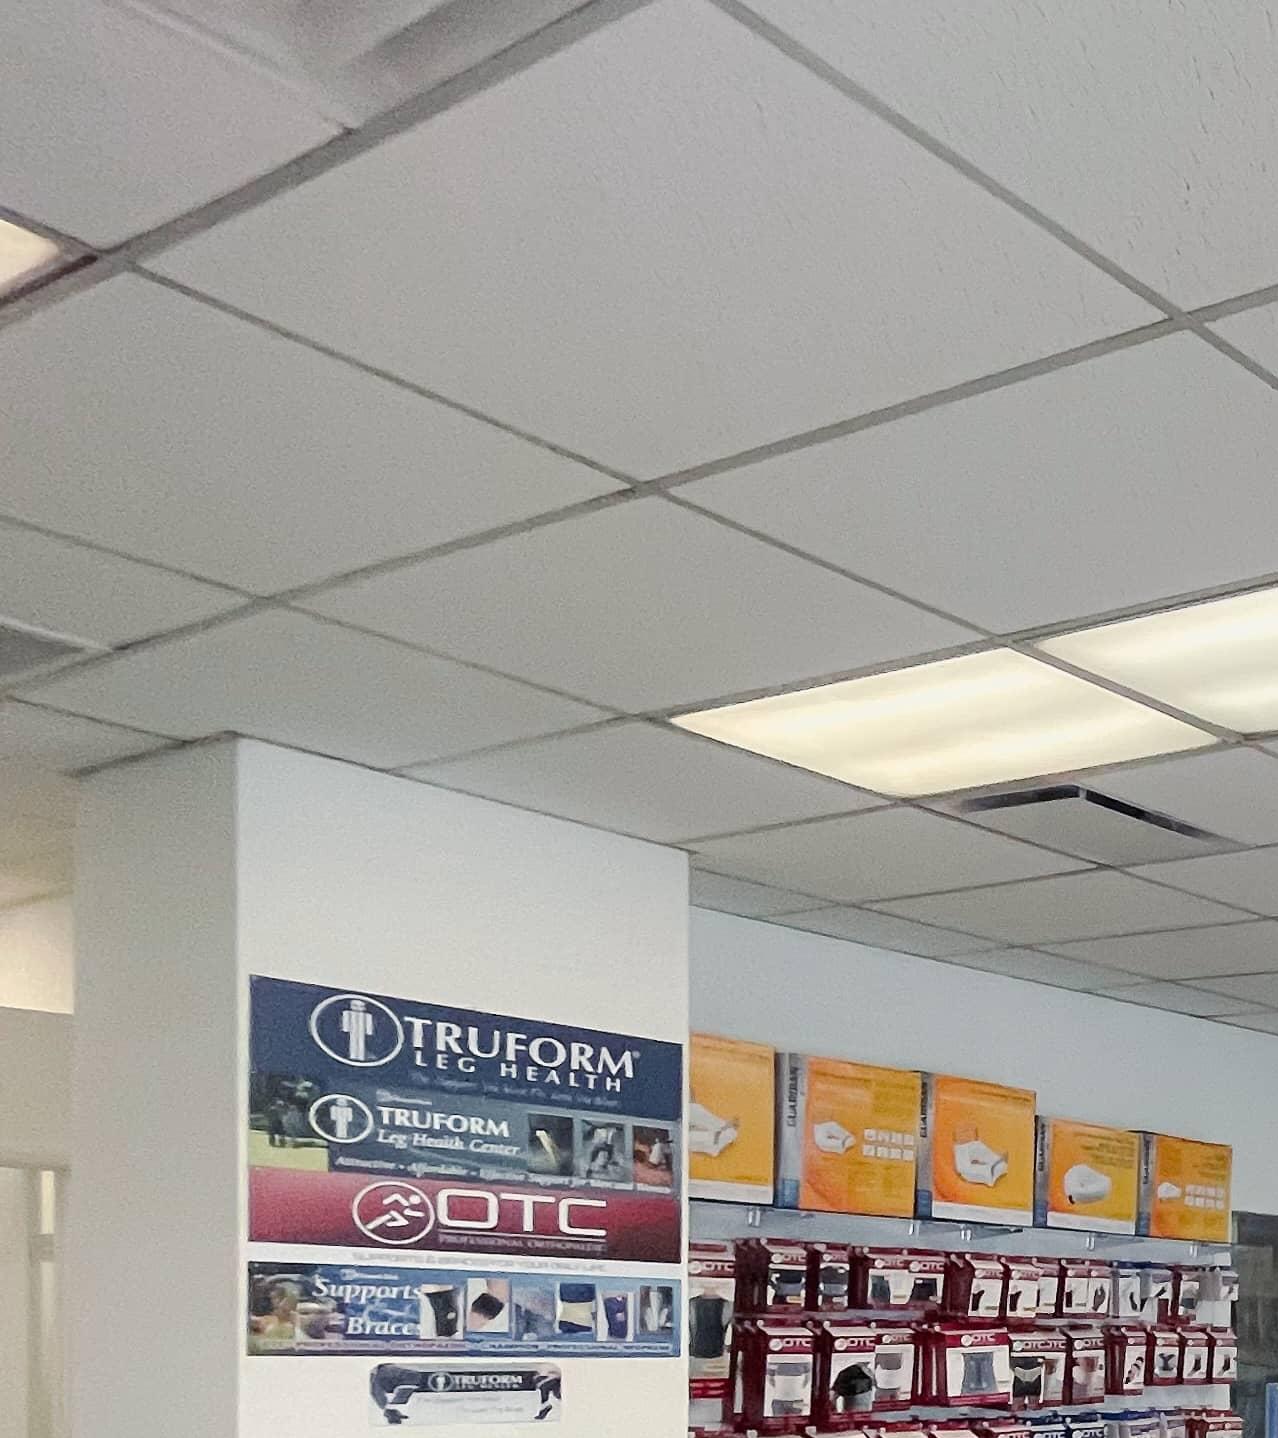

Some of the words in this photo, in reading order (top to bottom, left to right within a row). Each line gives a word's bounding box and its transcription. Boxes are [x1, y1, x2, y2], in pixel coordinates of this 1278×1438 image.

[403, 1016, 634, 1078] TRUFORM
[415, 1050, 476, 1073] LEG
[500, 1062, 621, 1093] HEALTH
[377, 1106, 510, 1139] TRUFORM
[376, 1129, 408, 1149] Leg
[412, 1131, 465, 1152] Health
[469, 1138, 521, 1157] Center
[436, 1188, 607, 1237] OTC
[783, 1253, 807, 1263] OTC
[703, 1263, 735, 1272] OTC
[920, 1261, 945, 1271] OTC
[312, 1275, 422, 1304] Supports
[783, 1338, 811, 1347] OTC
[848, 1337, 875, 1347] OTC
[972, 1333, 997, 1343] OTC
[454, 1374, 523, 1385] TRUFORM
